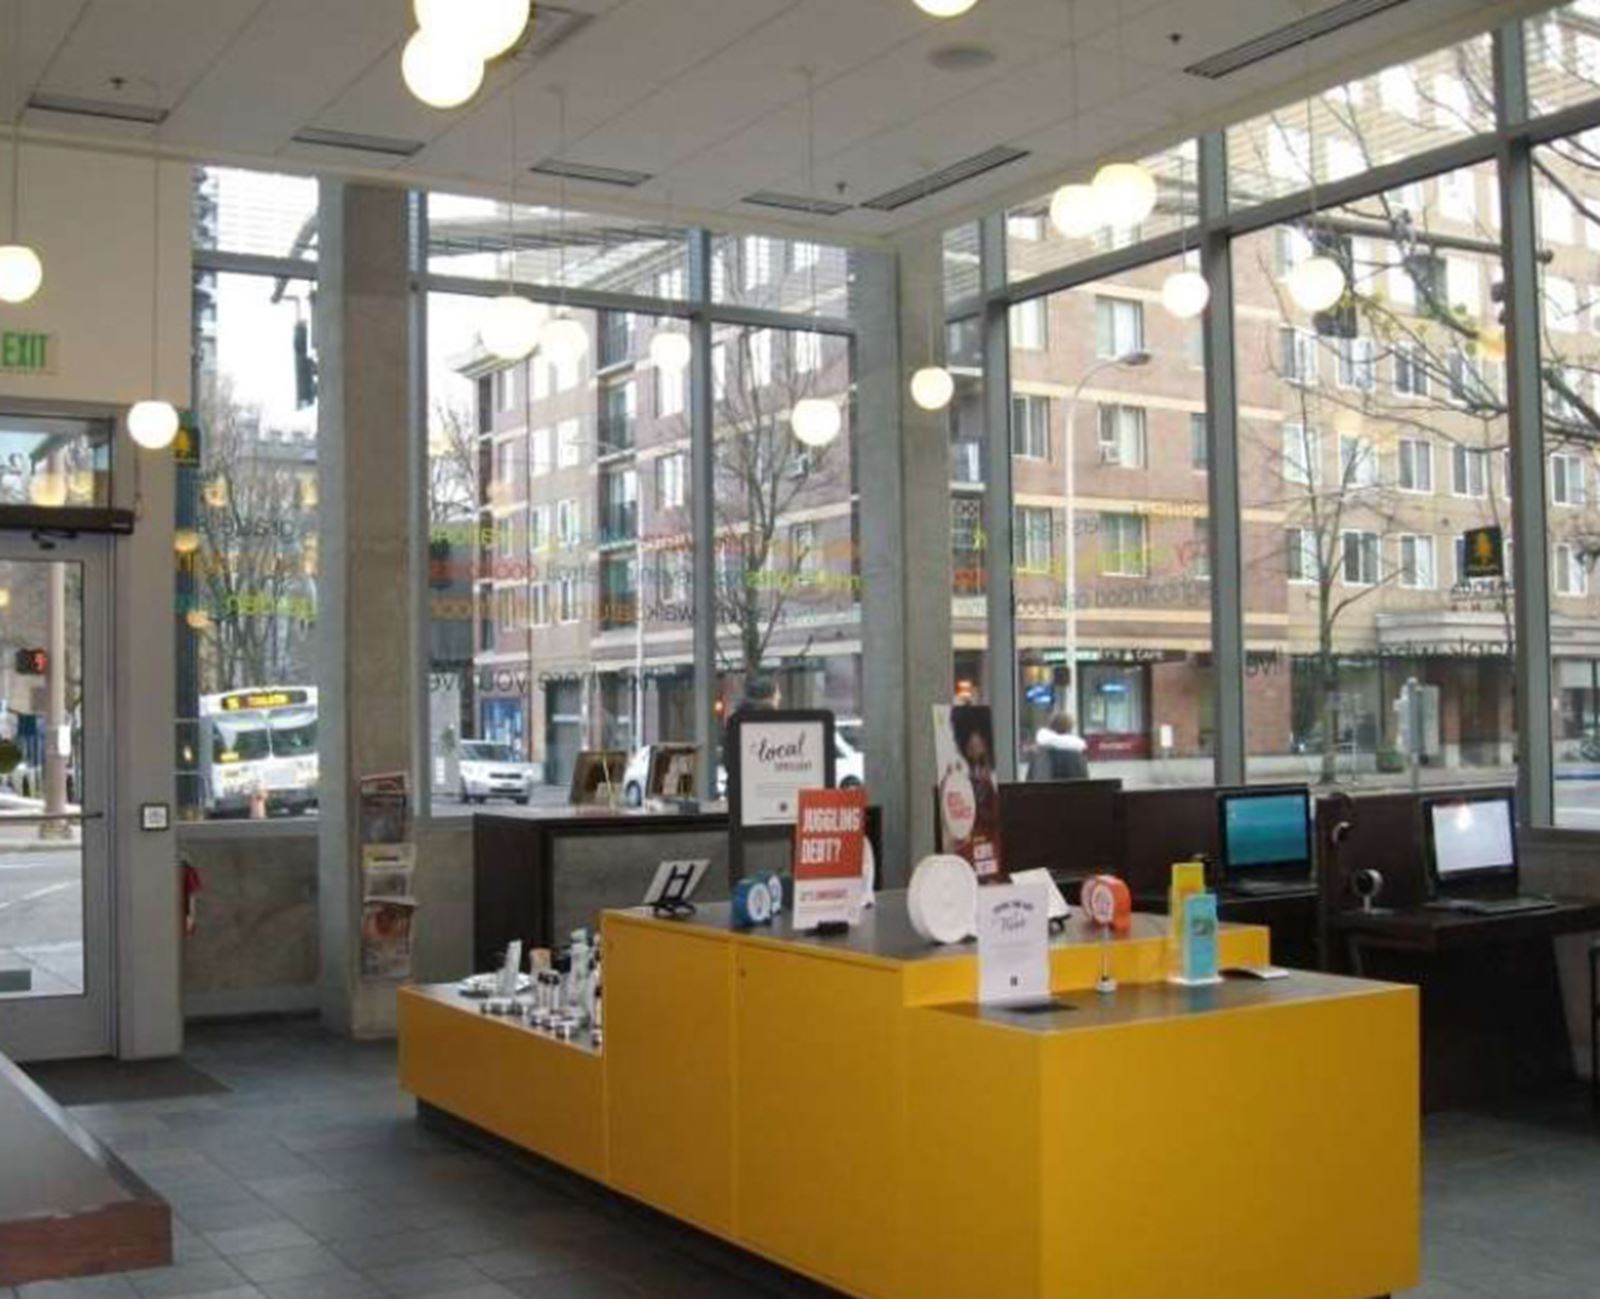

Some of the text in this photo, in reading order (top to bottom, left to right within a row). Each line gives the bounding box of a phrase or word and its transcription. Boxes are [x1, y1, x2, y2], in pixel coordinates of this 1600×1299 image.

[3, 332, 48, 367] EXIT
[802, 807, 862, 832] JUGGLING
[800, 838, 842, 864] DEBT?
